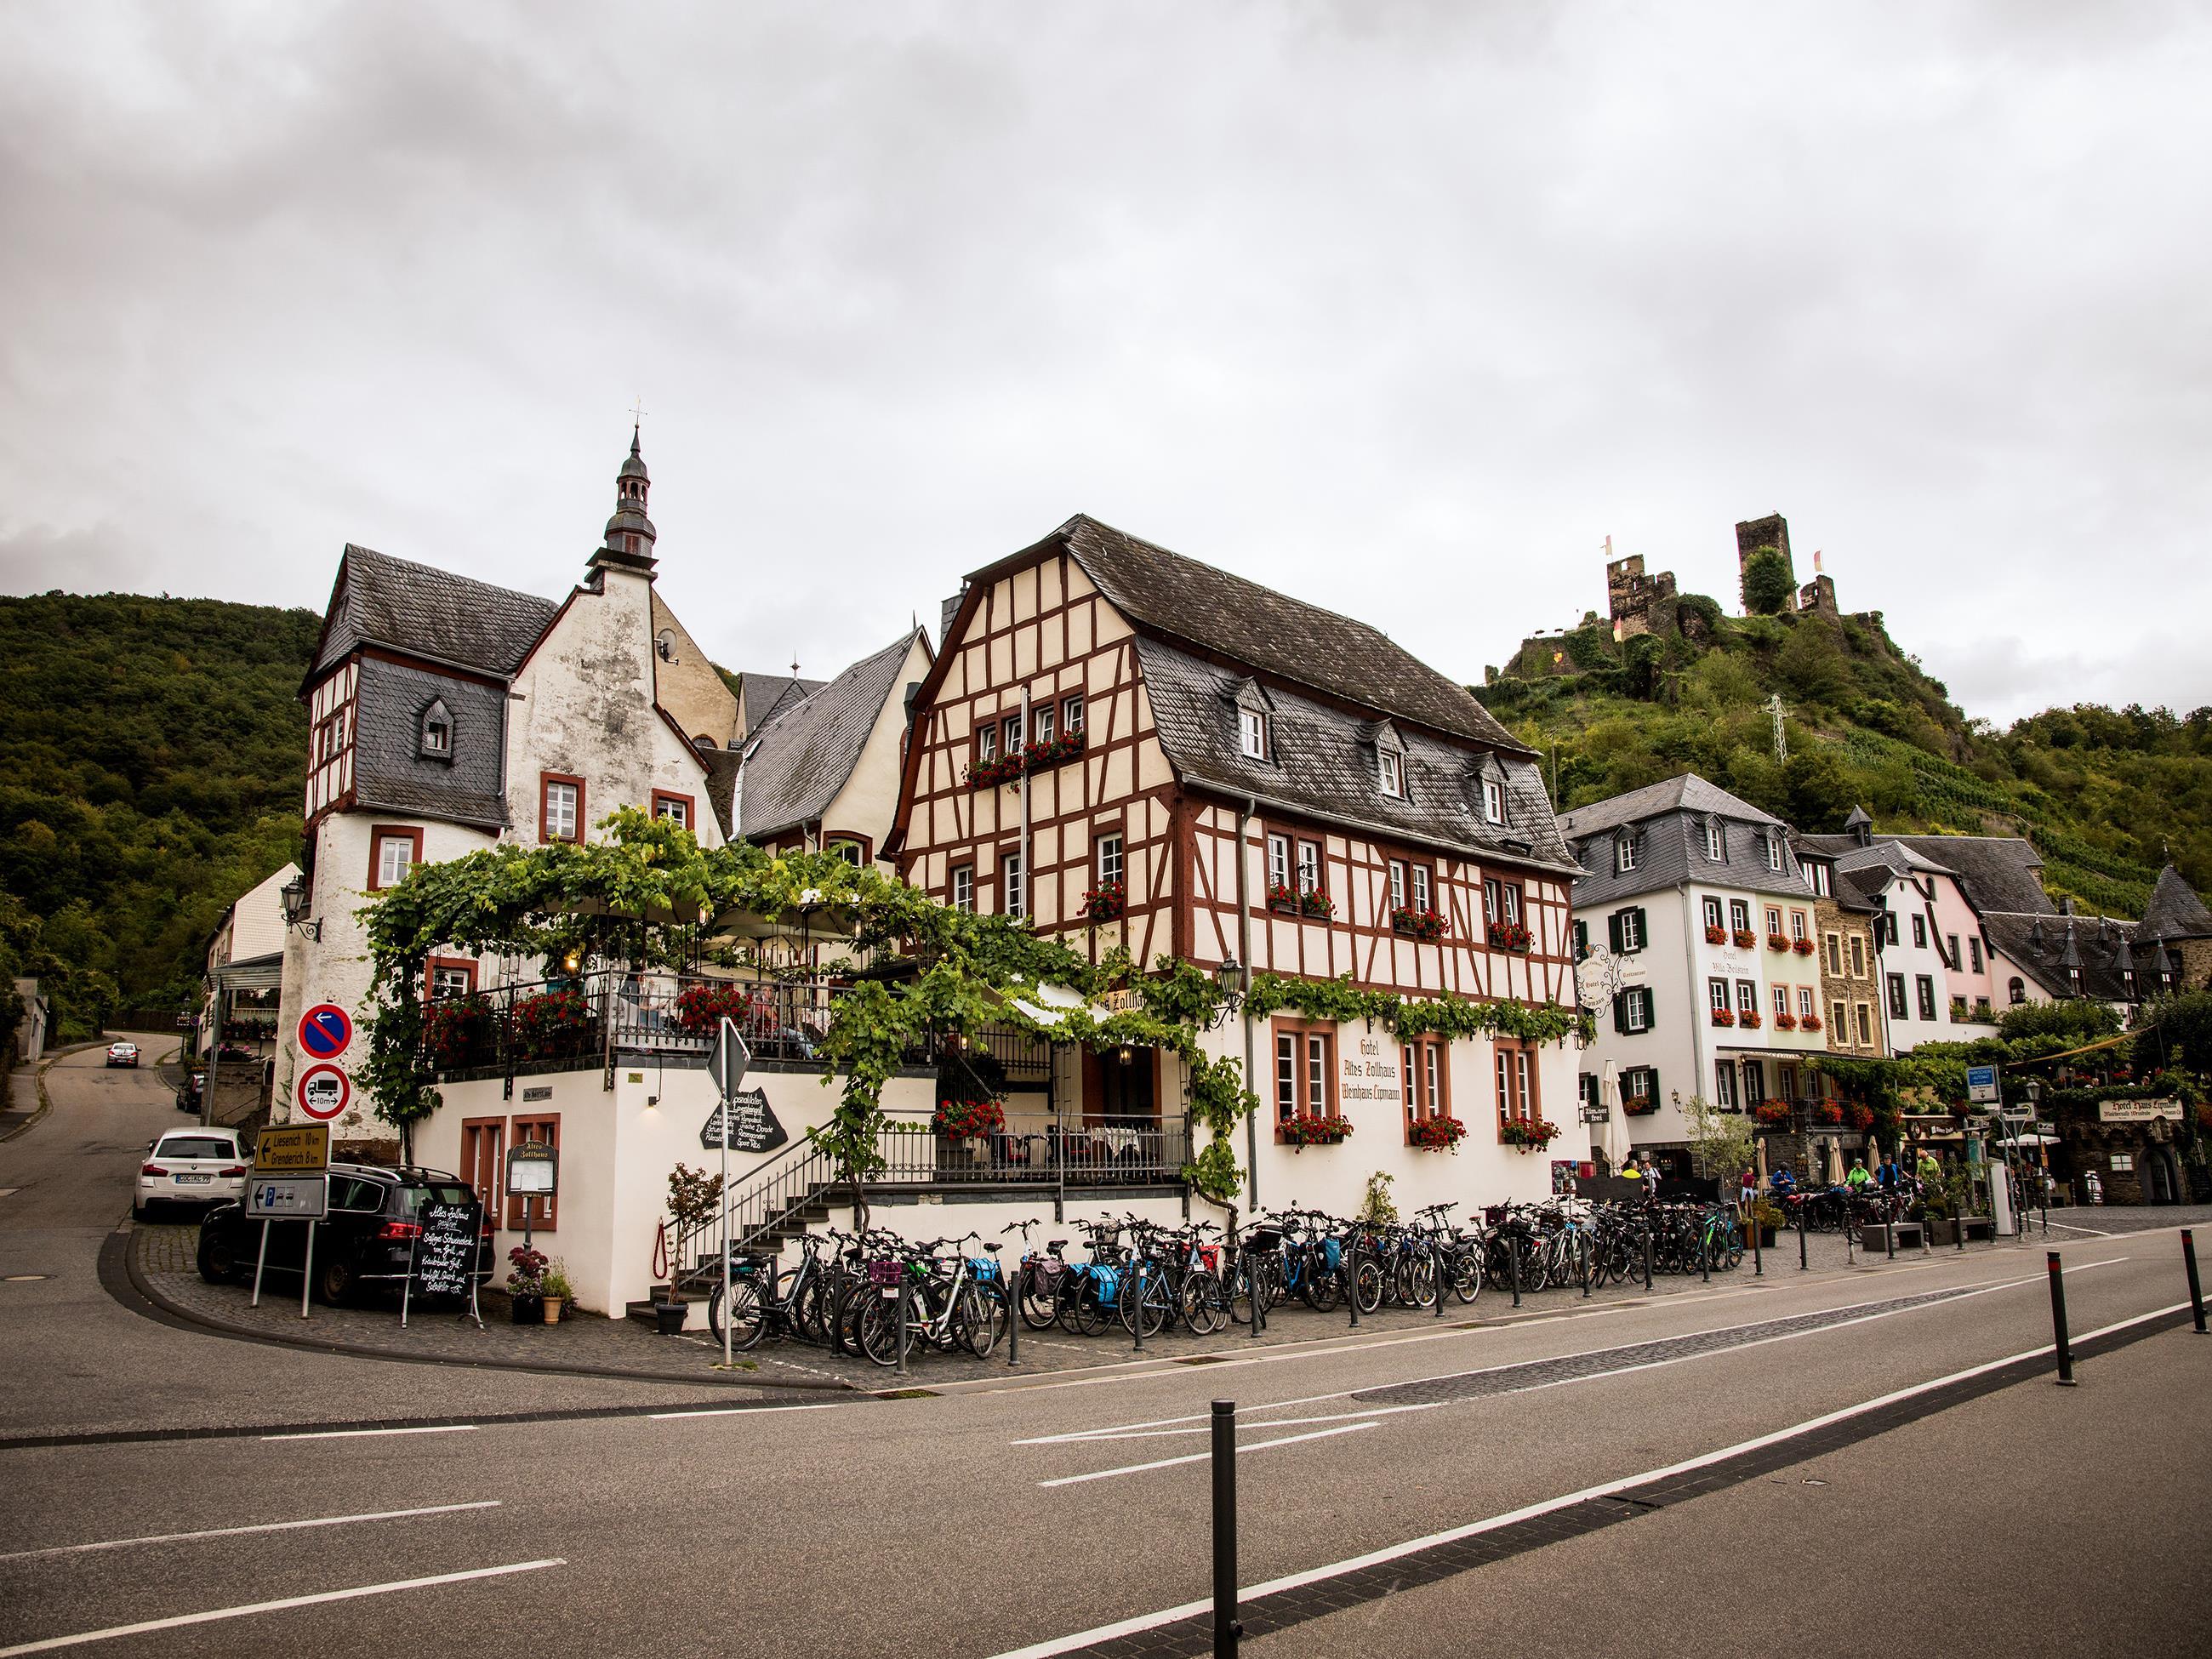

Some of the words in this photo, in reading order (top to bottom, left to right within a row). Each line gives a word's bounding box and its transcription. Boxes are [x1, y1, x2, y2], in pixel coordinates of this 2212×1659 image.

[1585, 980, 1599, 989] Hotel
[1360, 1039, 1380, 1057] Hotel
[1344, 1059, 1363, 1077] Altes
[1365, 1061, 1396, 1079] Zollhaus
[1342, 1082, 1373, 1101] Weinhaus
[1373, 1084, 1400, 1101] Lipmann
[2112, 1100, 2131, 1110] Hotel
[2133, 1101, 2152, 1110] Haus
[755, 1124, 773, 1133] Dorade
[273, 1132, 300, 1147] Liesenich
[305, 1132, 311, 1145] 10
[312, 1136, 320, 1145] km
[737, 1138, 750, 1148] Spare
[750, 1139, 761, 1149] Ribs
[271, 1152, 304, 1165] Grenderich
[305, 1151, 311, 1164] 8
[520, 1150, 549, 1159] Zollhaus
[429, 1205, 447, 1217] Altes
[448, 1206, 470, 1220] Zollhaus
